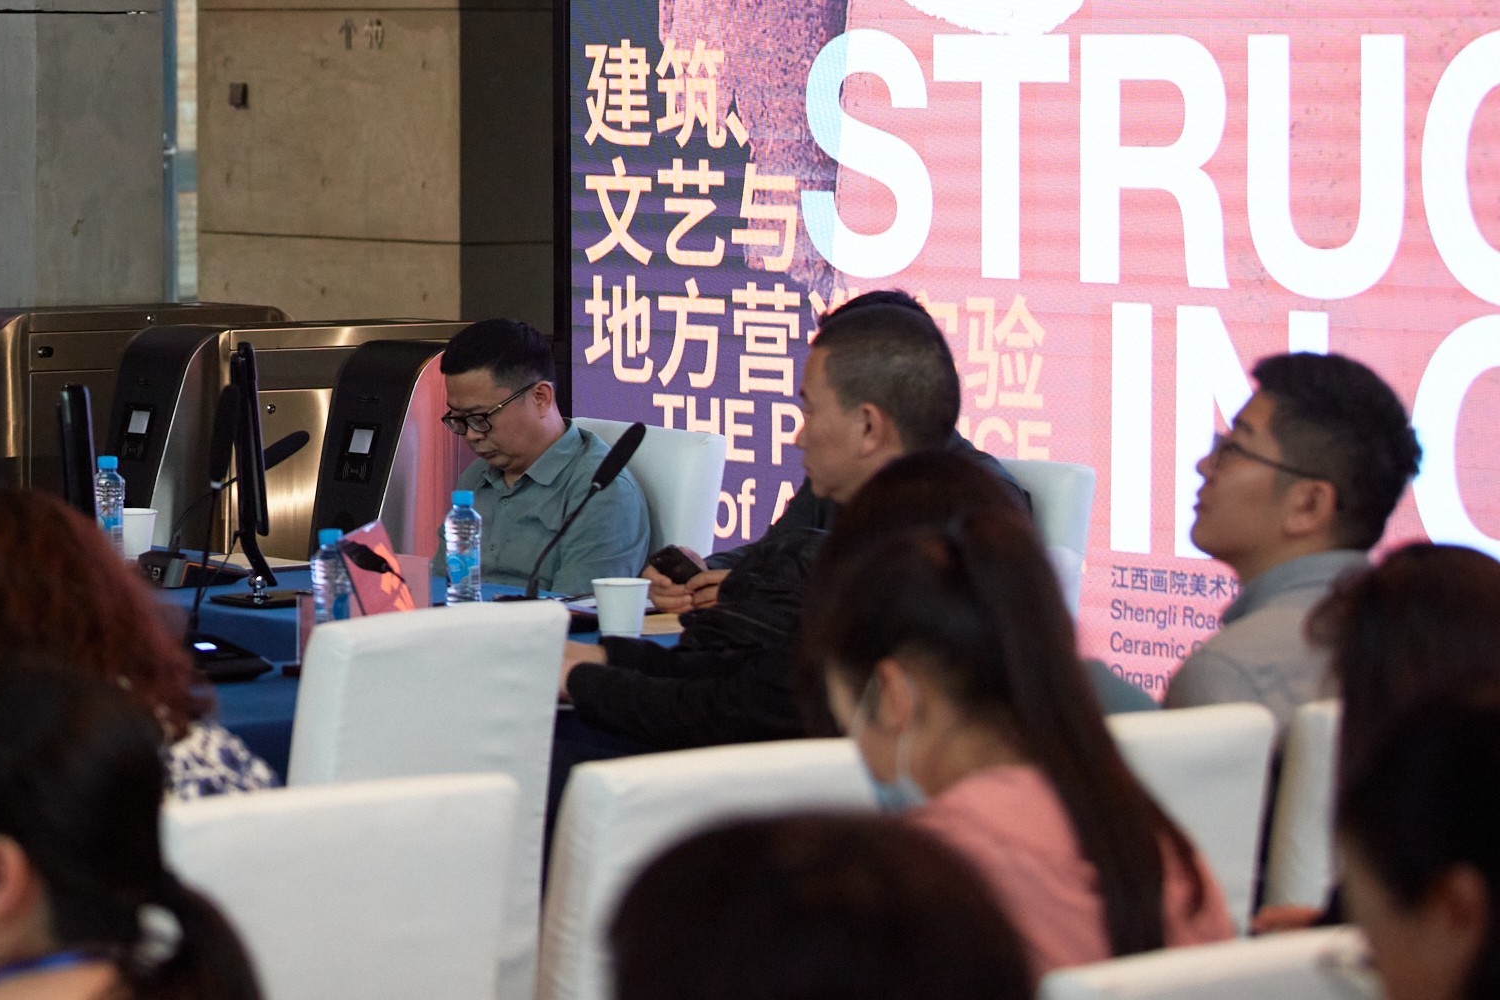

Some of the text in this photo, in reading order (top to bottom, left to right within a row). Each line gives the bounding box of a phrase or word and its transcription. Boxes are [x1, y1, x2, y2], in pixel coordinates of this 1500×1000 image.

[584, 157, 798, 272] 文艺与
[584, 275, 1045, 410] 地方营验
[652, 393, 756, 463] THE
[713, 478, 757, 541] of
[1109, 631, 1187, 660] Ceramic
[1110, 599, 1177, 631] Shengli
